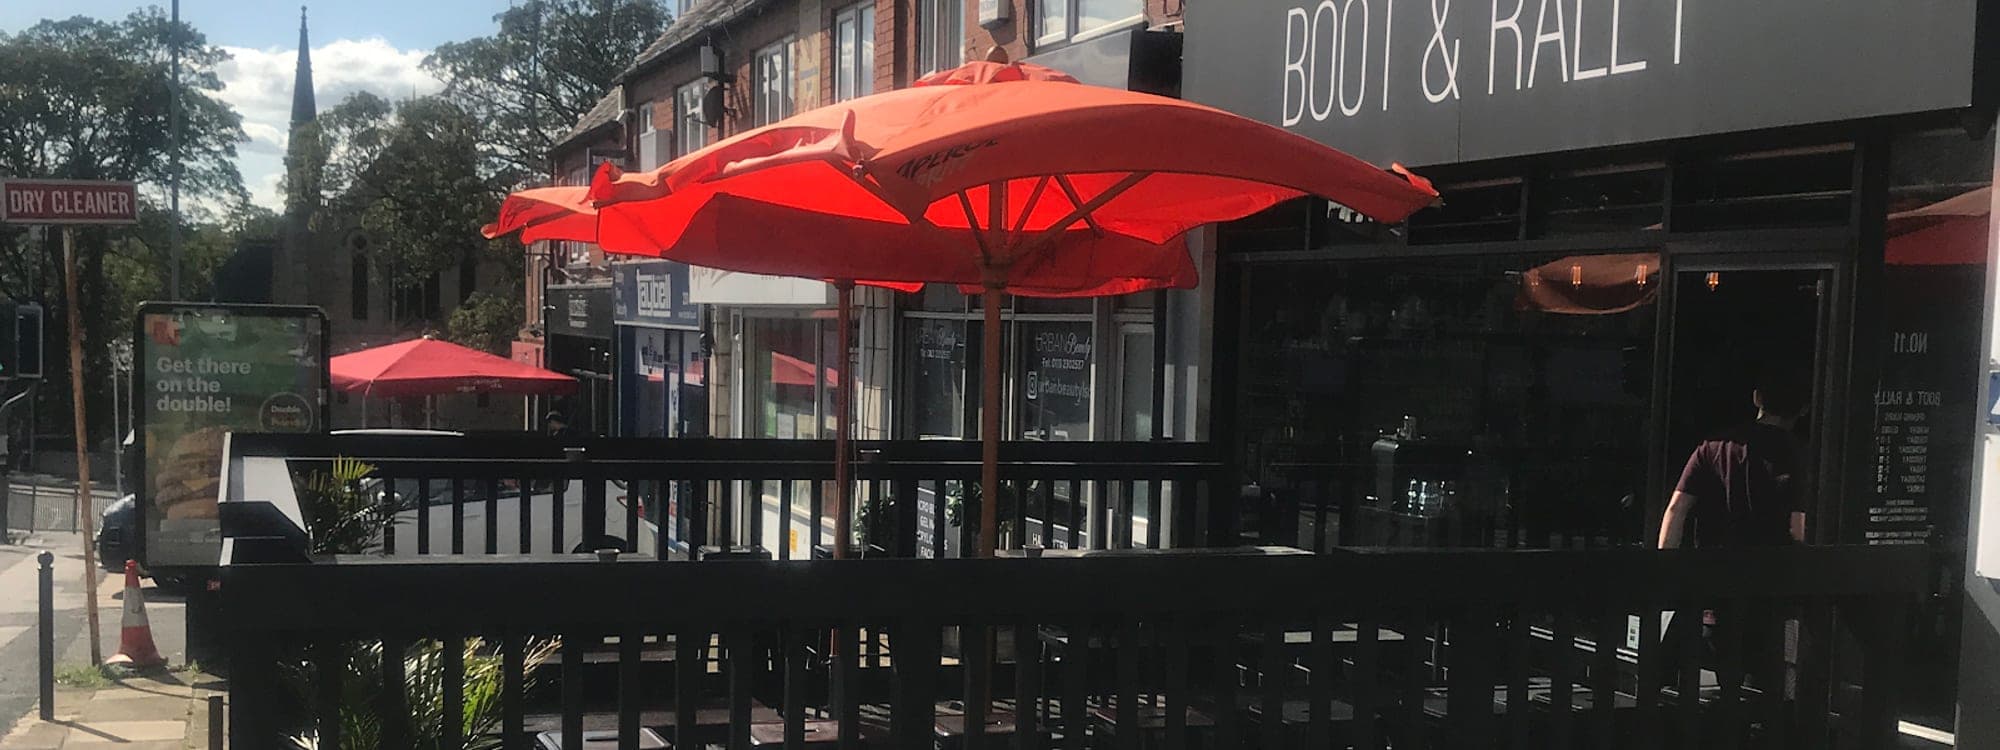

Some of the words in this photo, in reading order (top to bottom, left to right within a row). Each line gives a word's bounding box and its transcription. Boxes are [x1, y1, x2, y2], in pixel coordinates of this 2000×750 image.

[1421, 0, 1460, 104] &
[10, 190, 45, 213] DRY
[51, 190, 130, 214] CLEANER
[156, 356, 193, 373] Get
[197, 357, 251, 374] there
[156, 380, 182, 392] on
[187, 378, 220, 393] the
[156, 395, 232, 413] double!
